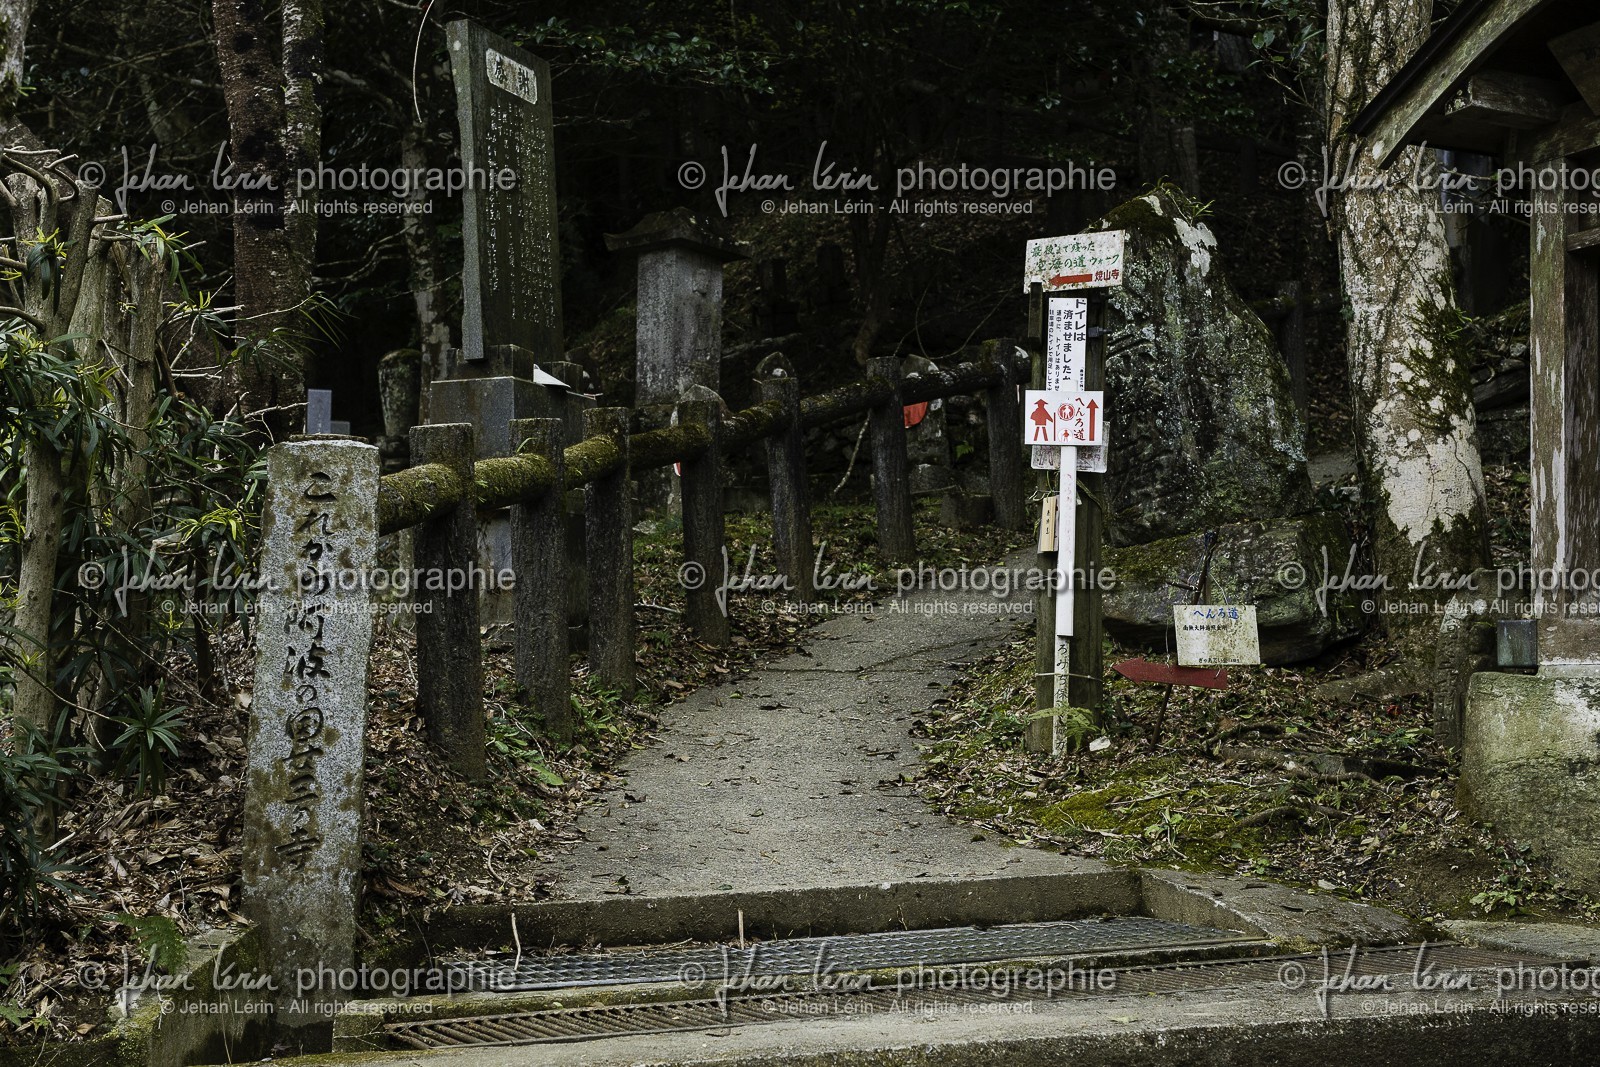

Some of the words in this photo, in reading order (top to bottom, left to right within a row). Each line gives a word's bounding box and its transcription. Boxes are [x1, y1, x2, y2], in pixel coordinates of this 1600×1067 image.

[1073, 299, 1086, 342] トイレは
[1073, 397, 1086, 441] へんろ道
[1193, 607, 1239, 620] へんろ道
